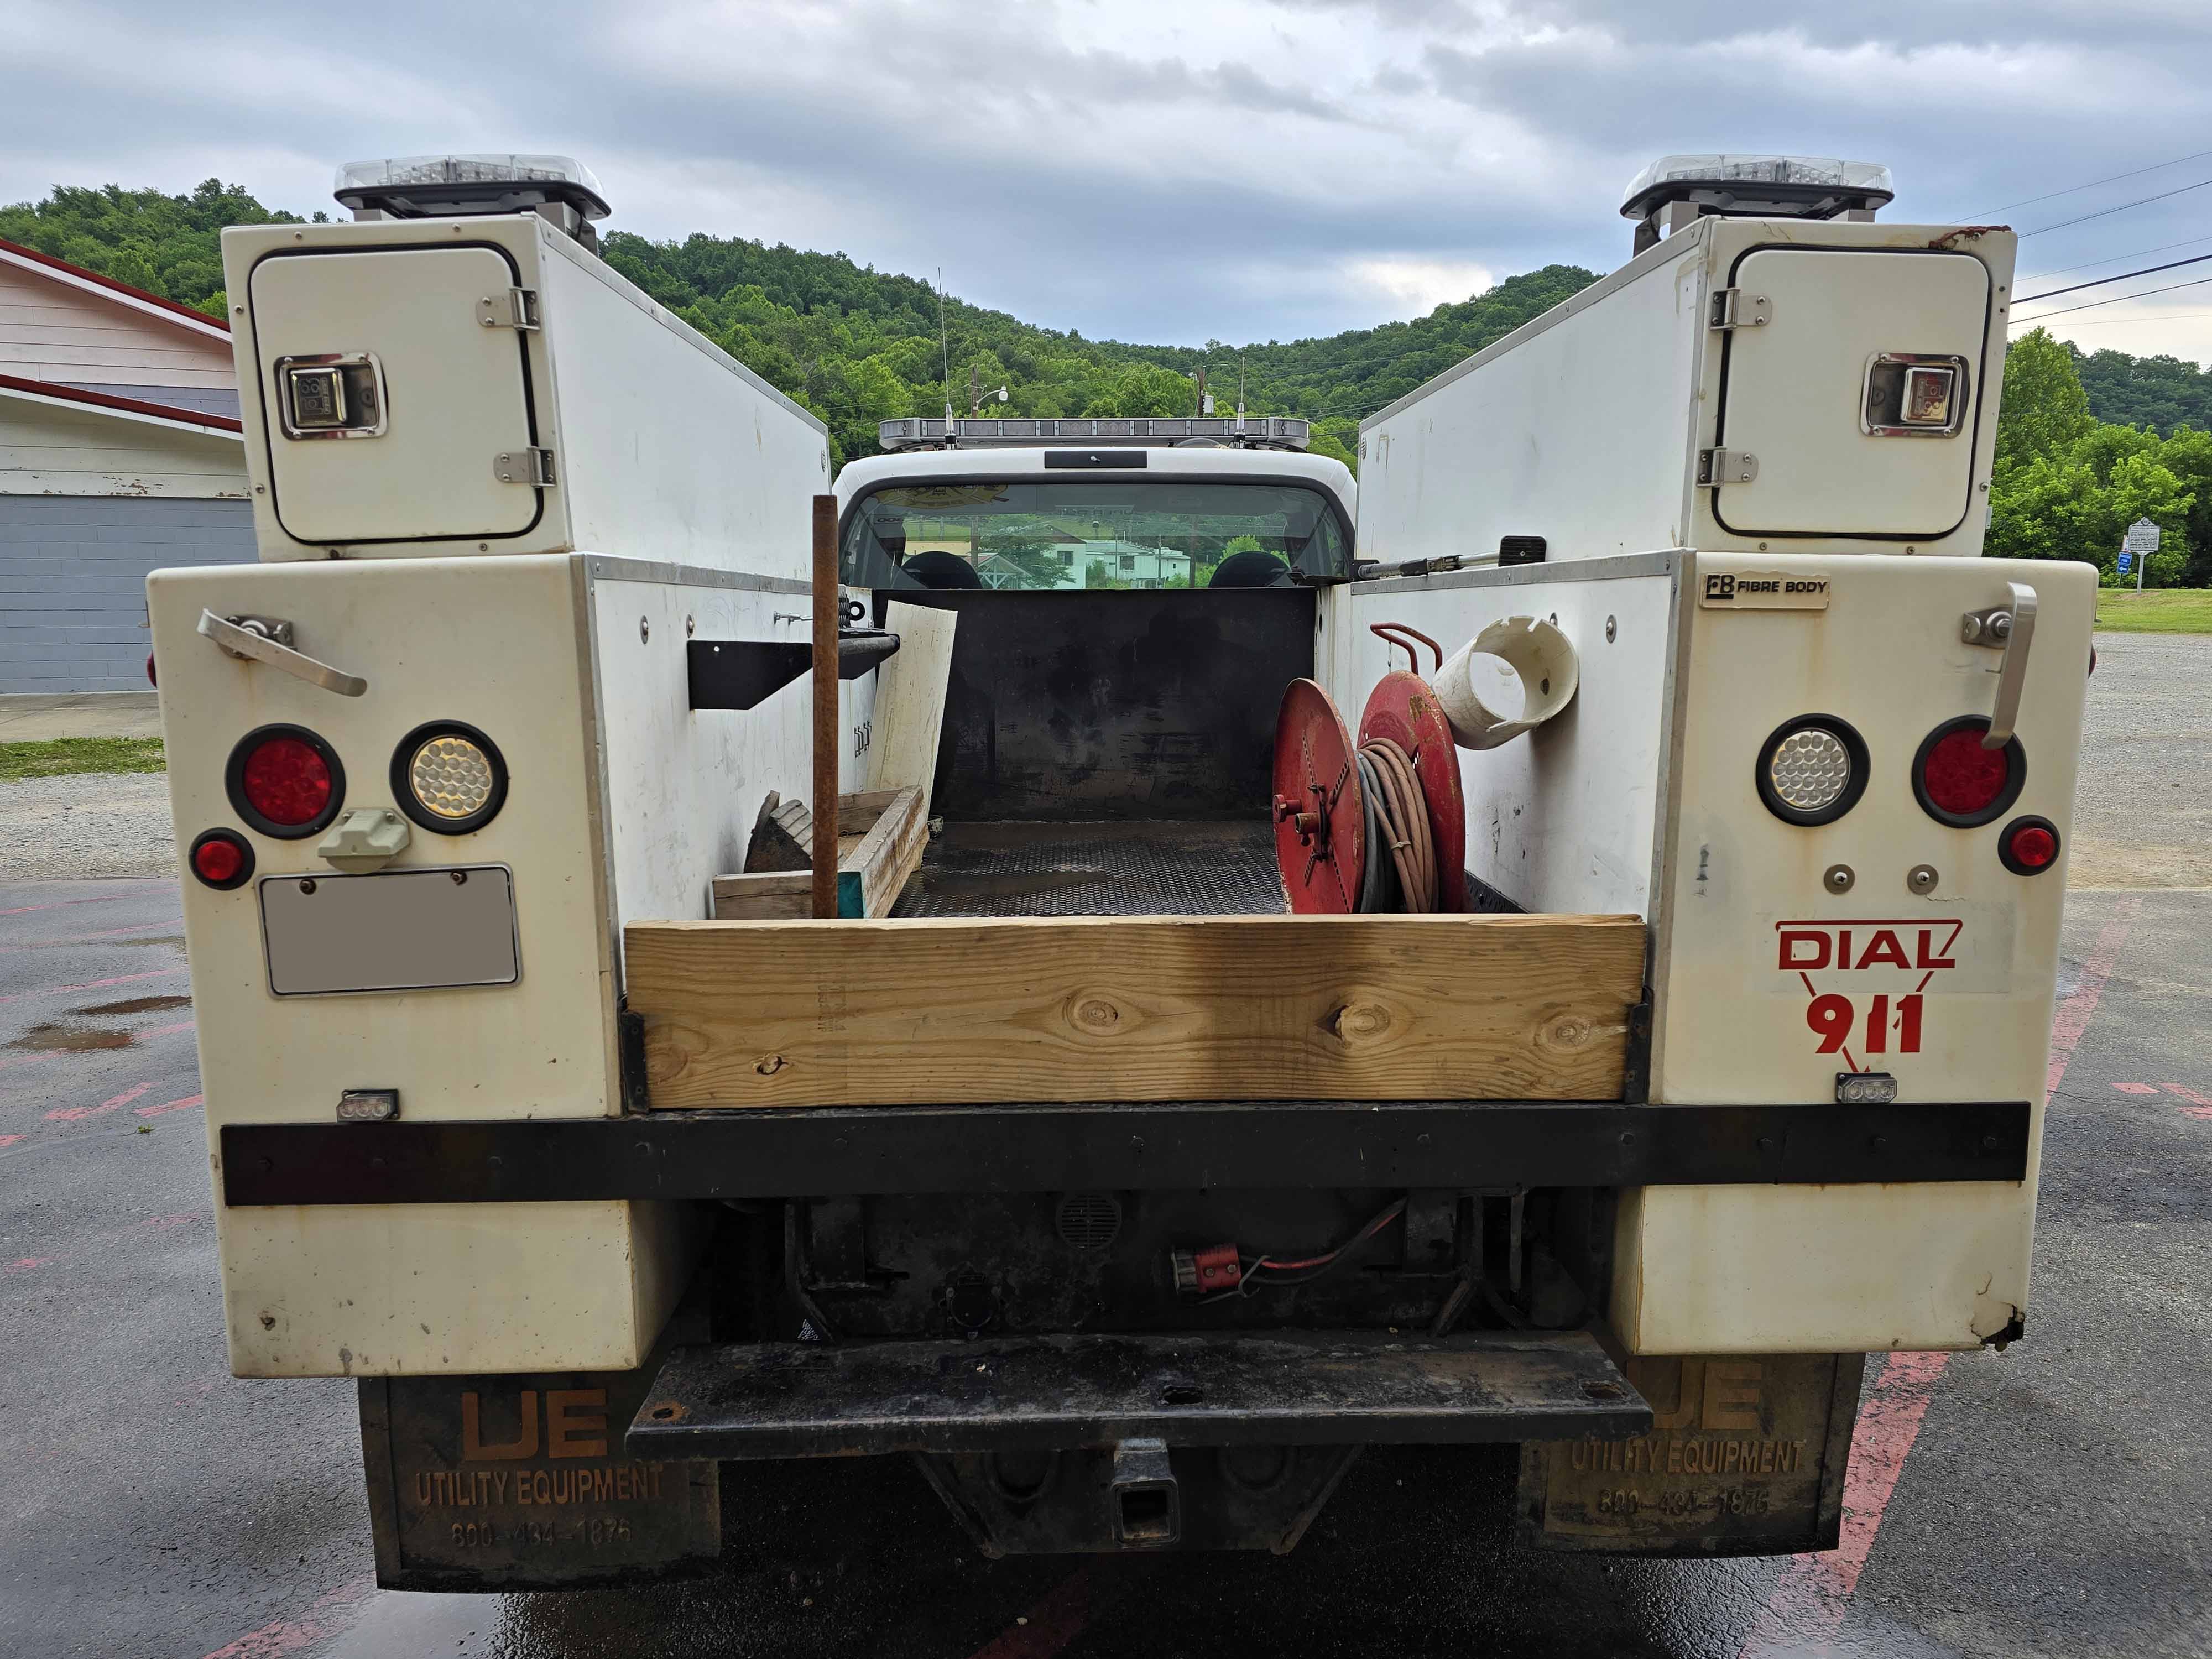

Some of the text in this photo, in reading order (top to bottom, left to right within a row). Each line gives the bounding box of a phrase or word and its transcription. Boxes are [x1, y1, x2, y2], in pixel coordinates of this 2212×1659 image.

[1737, 581, 1780, 592] FIBRE
[1785, 581, 1828, 593] BODY
[1778, 930, 1956, 970] DIAL
[1806, 993, 1924, 1054] 911
[461, 1389, 608, 1461] UE
[1571, 1438, 1807, 1474] UTILITY EQUIPMENT
[415, 1464, 664, 1506] UTILITY EQUIPMENT
